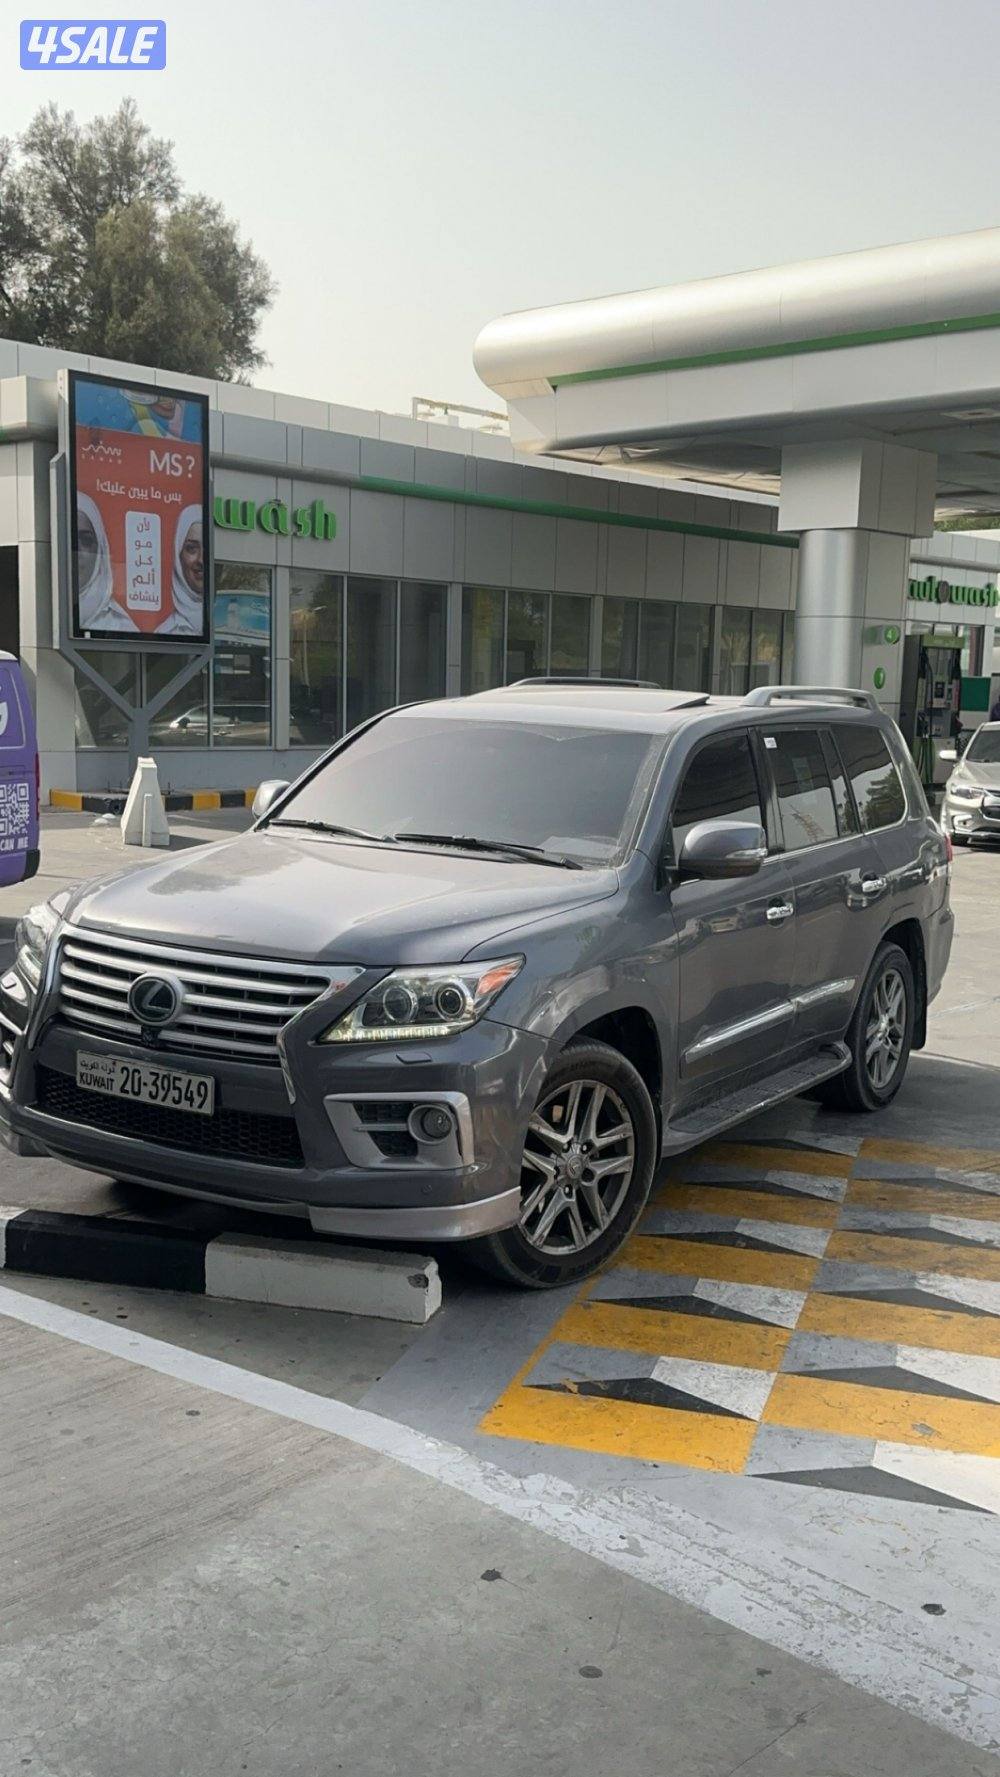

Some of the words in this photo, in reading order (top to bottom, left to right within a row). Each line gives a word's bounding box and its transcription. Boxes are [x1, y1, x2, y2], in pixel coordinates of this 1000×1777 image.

[149, 449, 195, 478] MS?
[151, 486, 161, 499] ما
[213, 496, 337, 540] wash
[79, 1072, 115, 1091] KUWAIT
[120, 1066, 208, 1109] 20-39549
